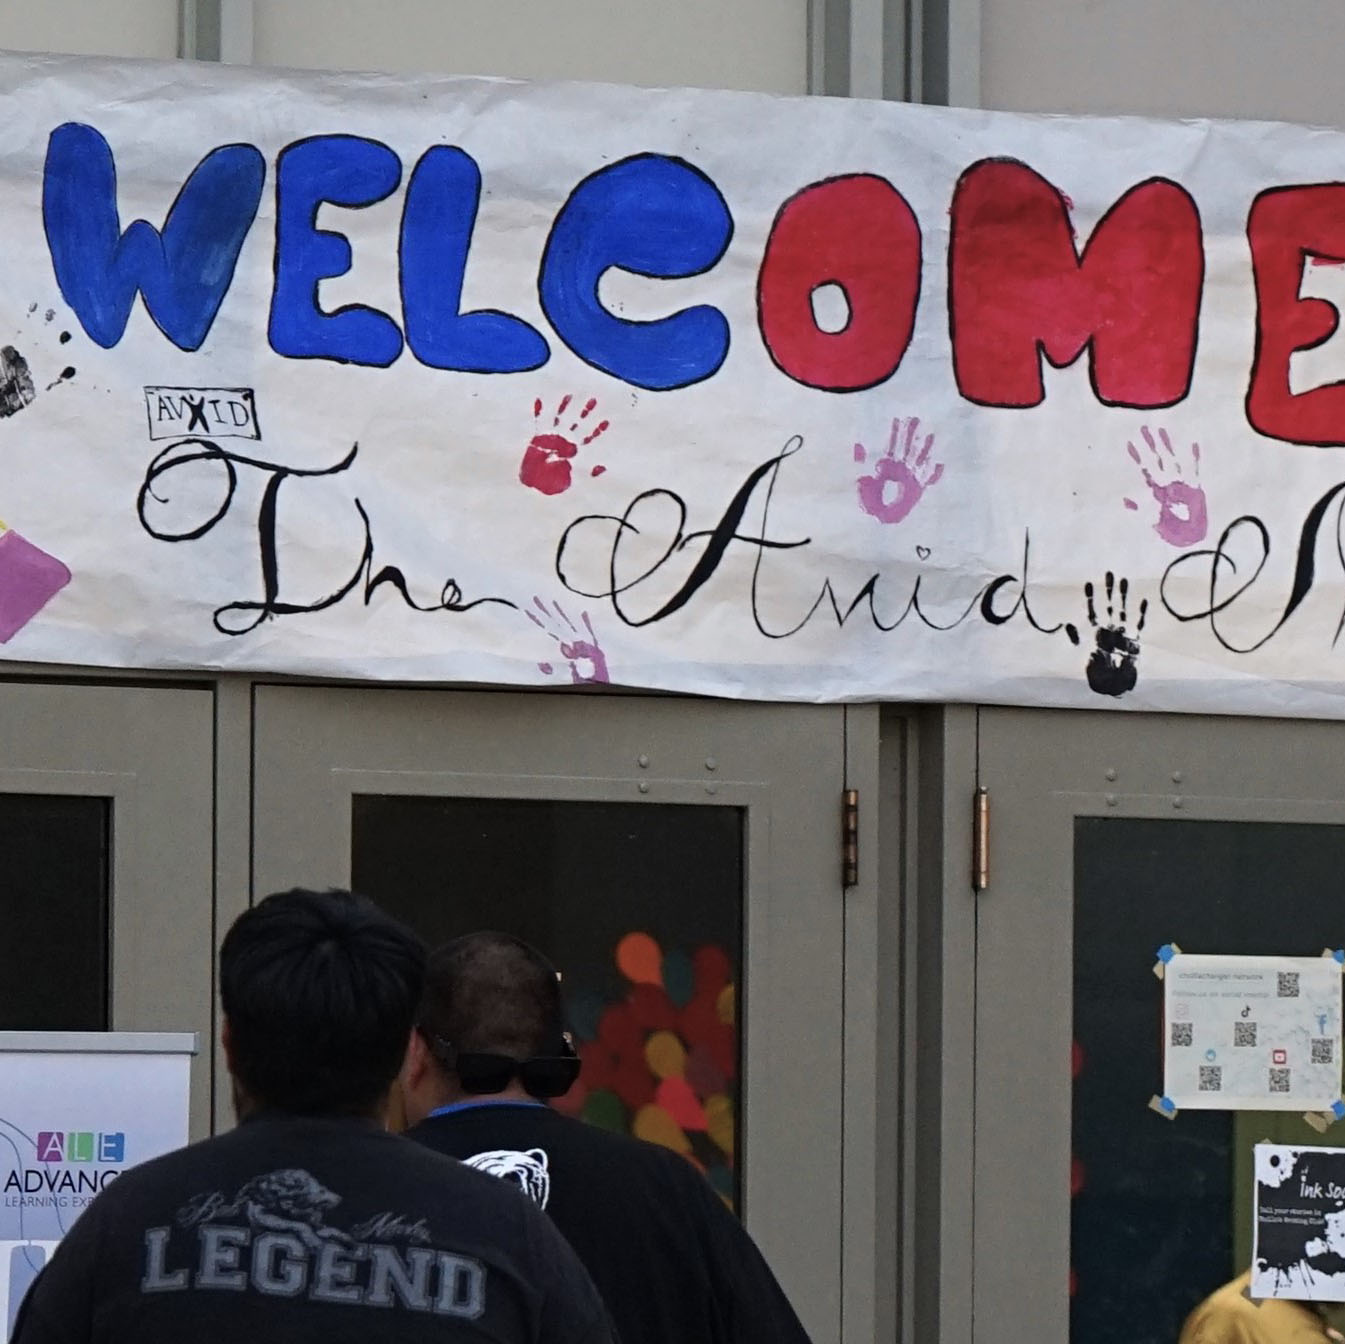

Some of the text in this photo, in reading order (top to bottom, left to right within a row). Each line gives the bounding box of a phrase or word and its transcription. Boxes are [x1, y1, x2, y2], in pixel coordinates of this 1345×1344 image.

[137, 438, 519, 636] The
[38, 1132, 123, 1161] ALE
[3, 1169, 119, 1194] ADVANC
[5, 1196, 68, 1208] LEARNING
[141, 1224, 488, 1321] LEGEND
